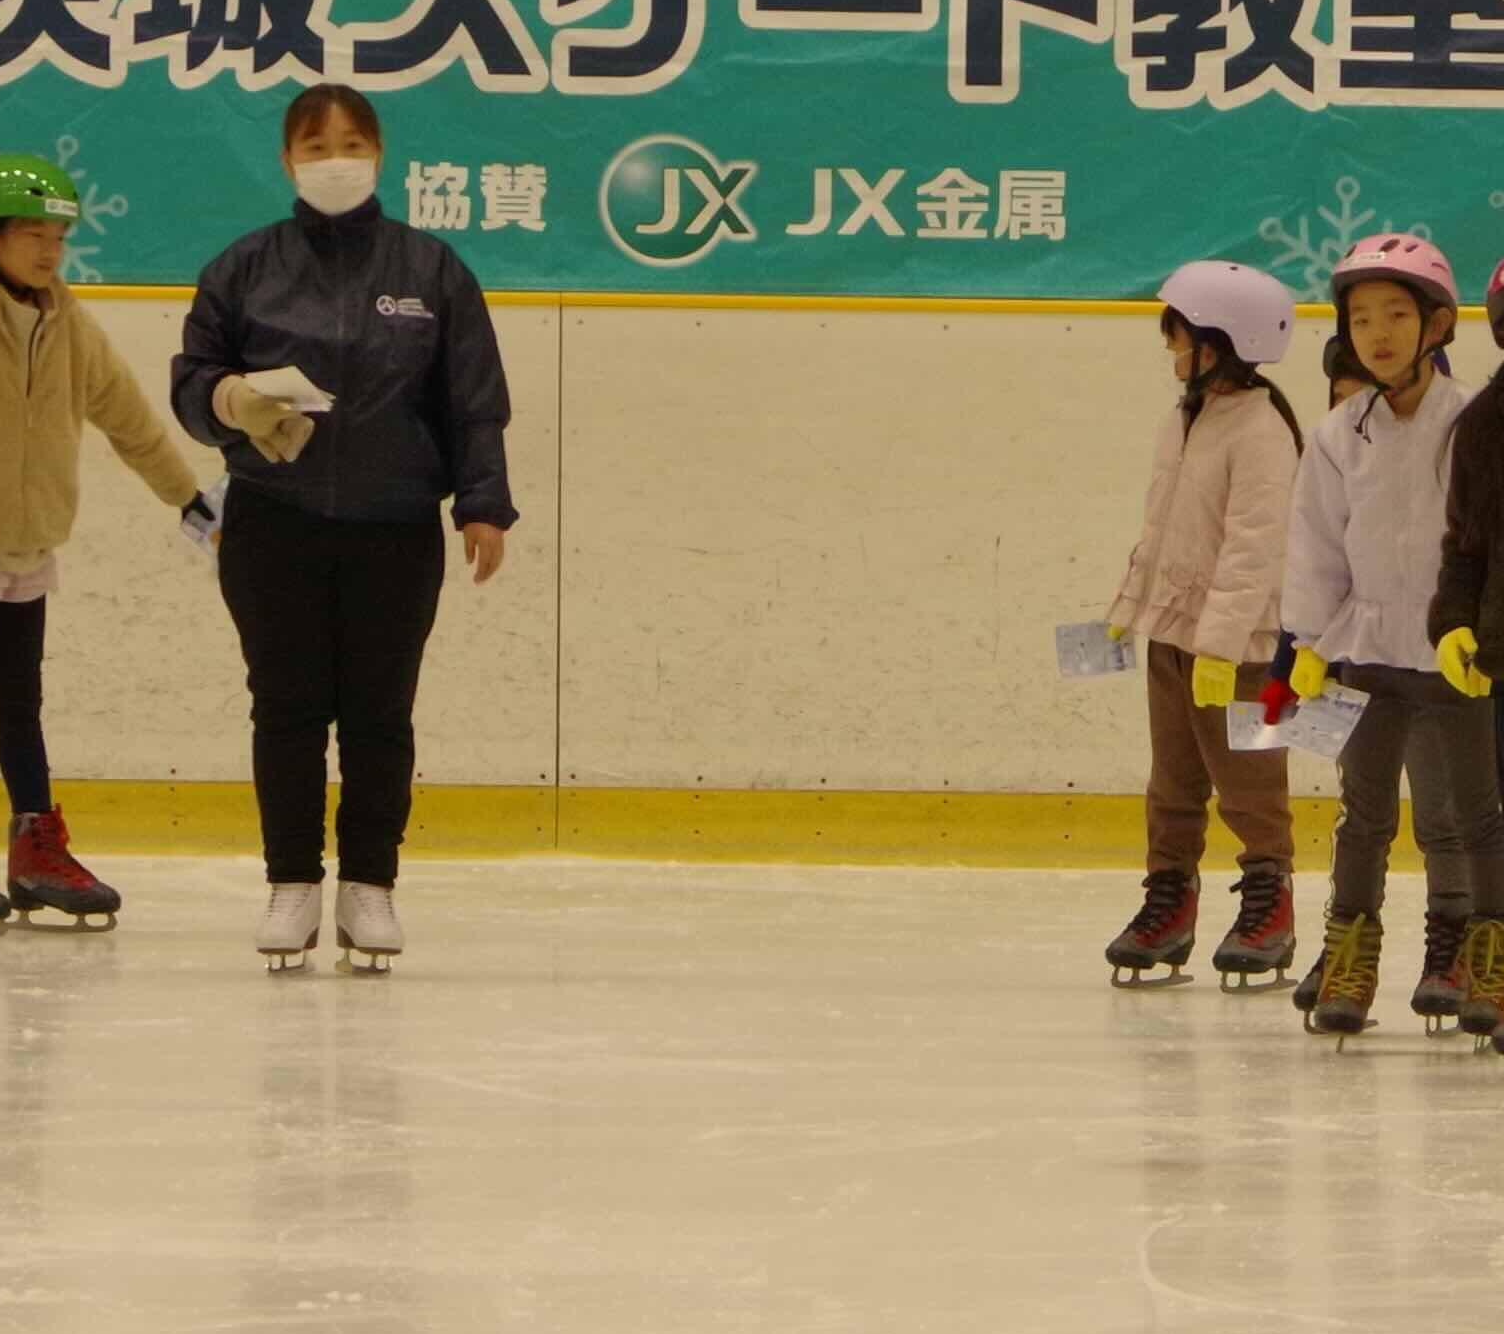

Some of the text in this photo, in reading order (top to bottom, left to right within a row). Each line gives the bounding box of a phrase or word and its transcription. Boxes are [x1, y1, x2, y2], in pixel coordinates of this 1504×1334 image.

[404, 161, 1066, 240] 協賛 JX JX金属
